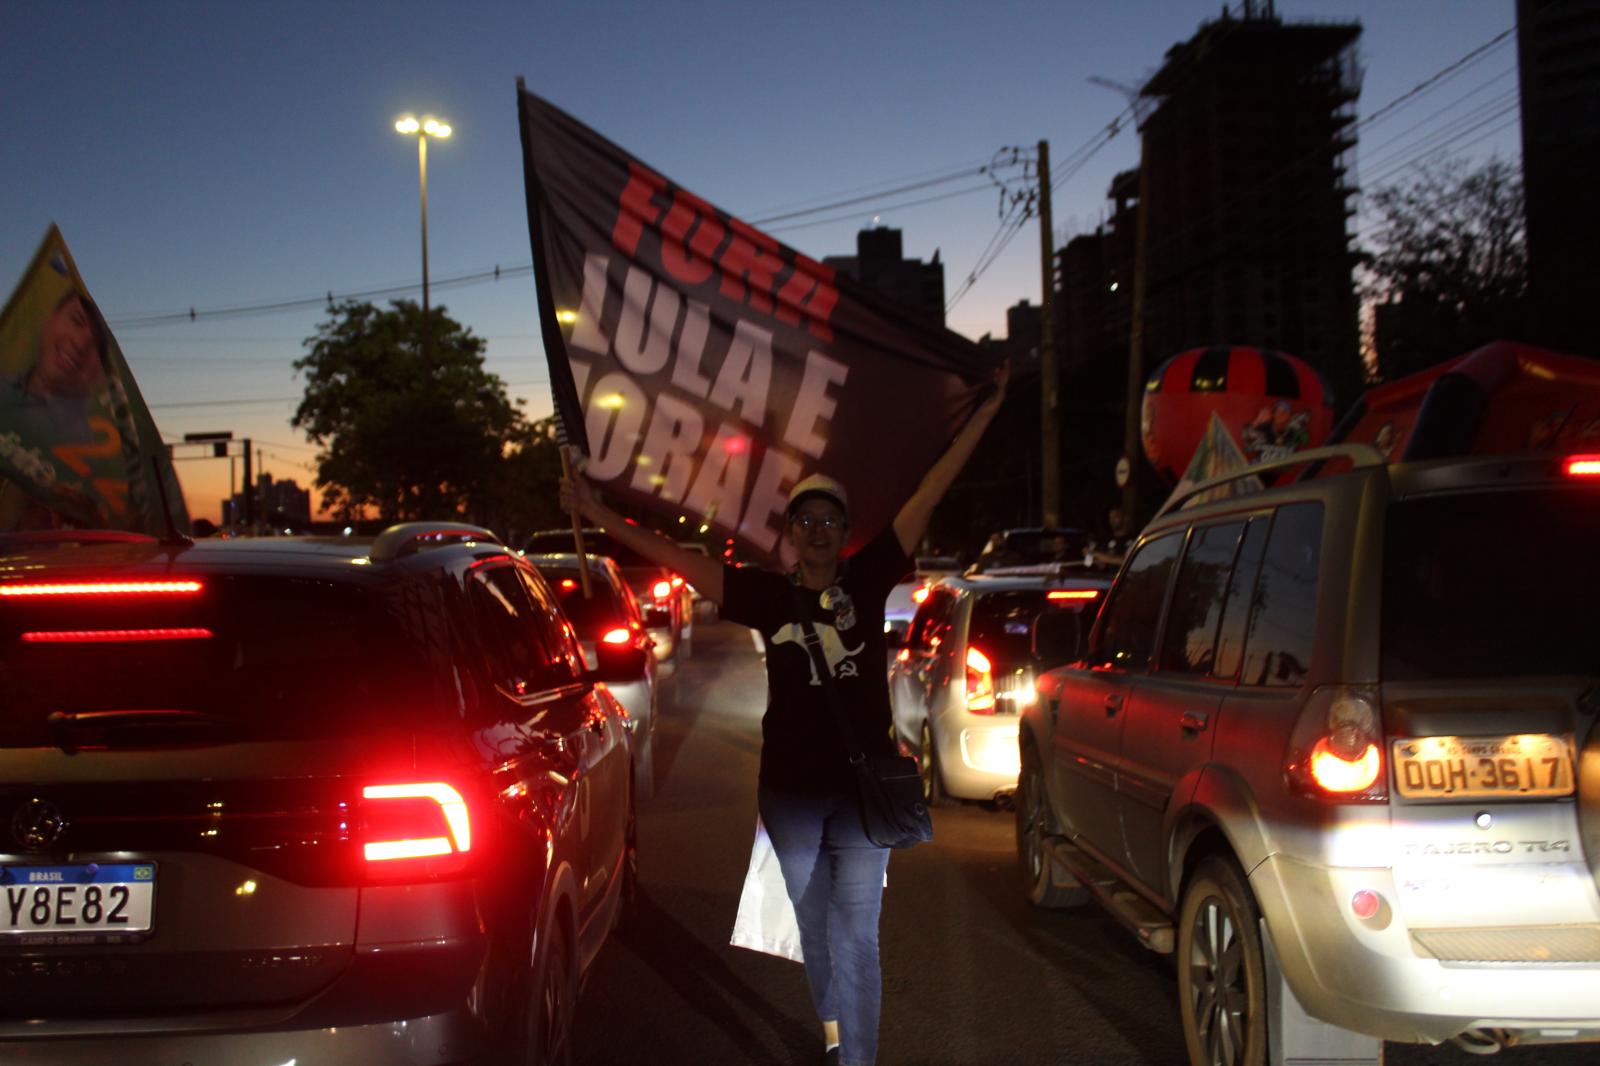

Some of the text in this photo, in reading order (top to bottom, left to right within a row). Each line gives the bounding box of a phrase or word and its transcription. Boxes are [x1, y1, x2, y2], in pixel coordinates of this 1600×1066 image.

[612, 160, 840, 343] FORA
[569, 251, 851, 460] LULA E
[570, 356, 804, 574] ORAE
[28, 871, 64, 882] BRASIL
[1404, 839, 1571, 855] PAJERO TR4
[7, 885, 130, 926] Y8E82
